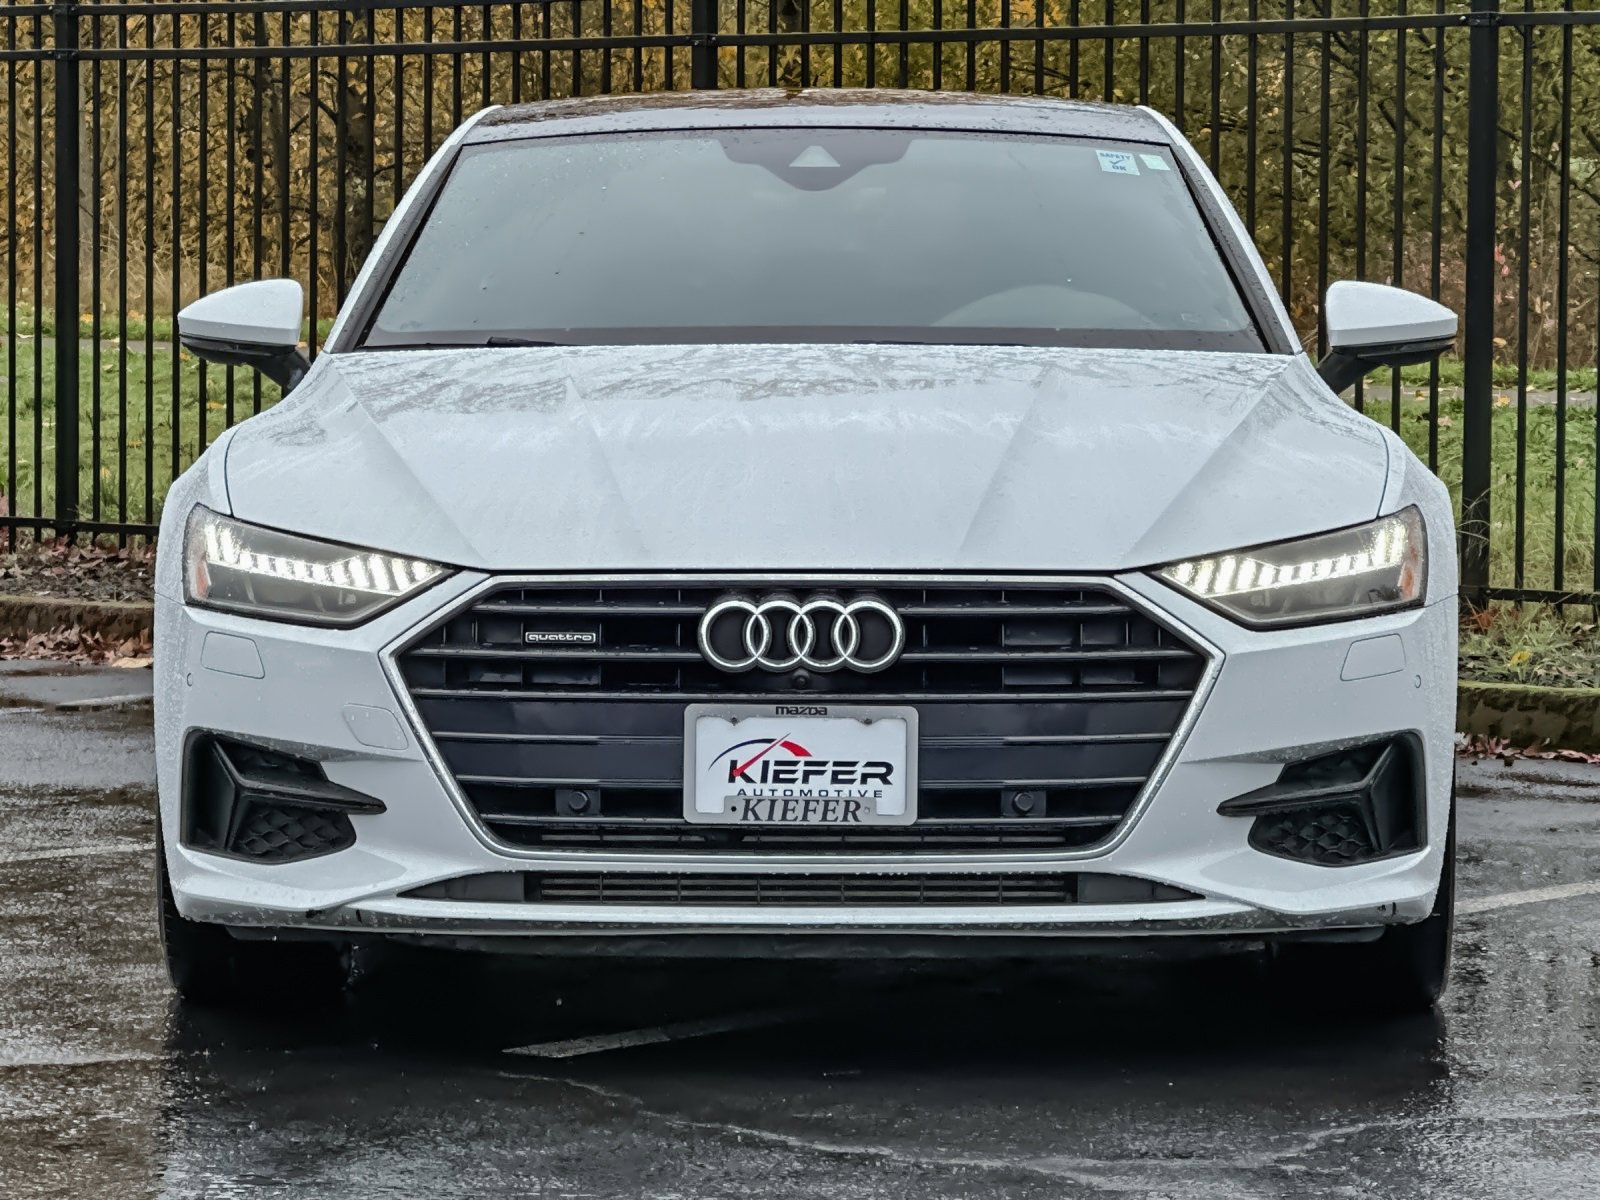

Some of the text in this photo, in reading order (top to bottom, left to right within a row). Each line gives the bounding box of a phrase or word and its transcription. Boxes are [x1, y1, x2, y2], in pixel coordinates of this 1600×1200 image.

[1099, 152, 1131, 160] SAFETY
[528, 633, 592, 642] quattro
[775, 706, 828, 716] mazda
[728, 759, 894, 785] KIEFER
[737, 788, 883, 798] AUTOMOTIVE
[739, 798, 862, 822] KIEFER
